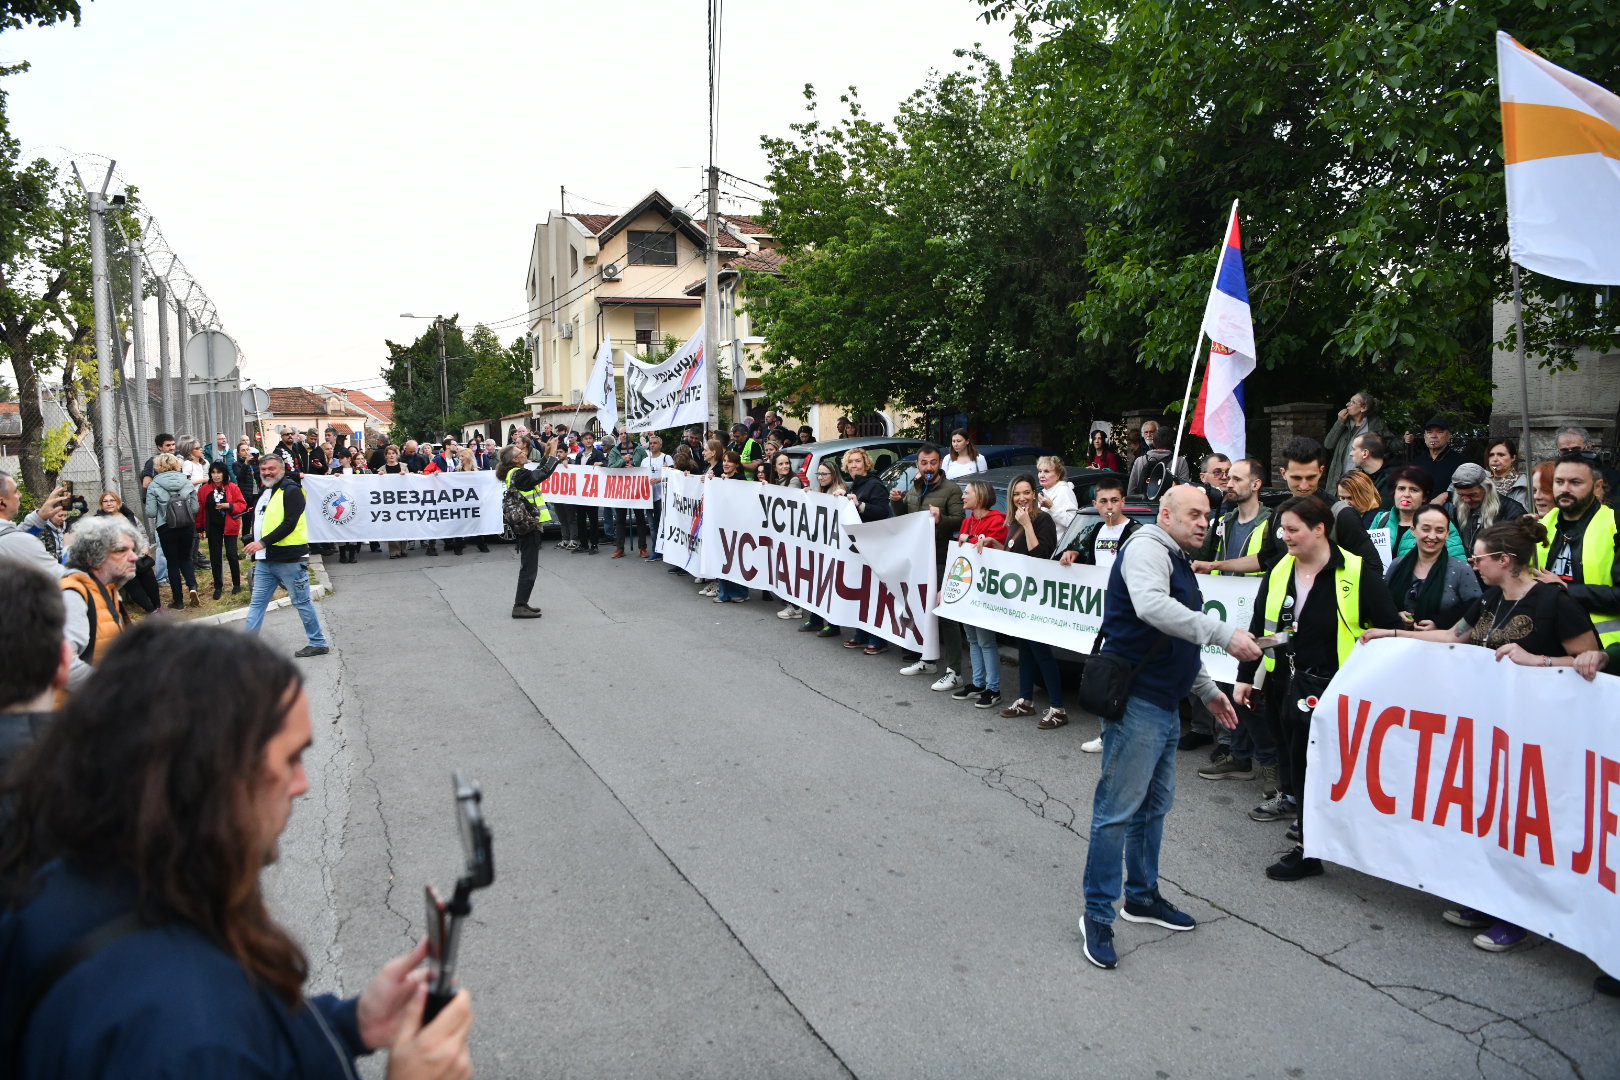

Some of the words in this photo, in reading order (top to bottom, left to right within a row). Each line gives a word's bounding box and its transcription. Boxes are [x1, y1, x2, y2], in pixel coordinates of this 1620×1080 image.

[370, 488, 479, 506] ЗВЕЗДАРА
[540, 471, 577, 496] BODA
[582, 474, 599, 498] ZA
[604, 475, 651, 500] MARIJU
[371, 511, 392, 523] УЗ
[396, 507, 481, 523] СТУДЕНТЕ
[758, 494, 840, 549] УСТАЛА
[667, 526, 680, 543] УЗ
[977, 566, 1037, 602] ЗБОР
[1040, 580, 1108, 617] ЛЕКИ
[983, 602, 1007, 615] ПАШИНО
[1008, 608, 1026, 619] БРДО
[1030, 613, 1068, 628] ВИНОГРАДИ
[1200, 644, 1227, 657] НОВАЦ
[1330, 694, 1555, 866] УСТАЛА
